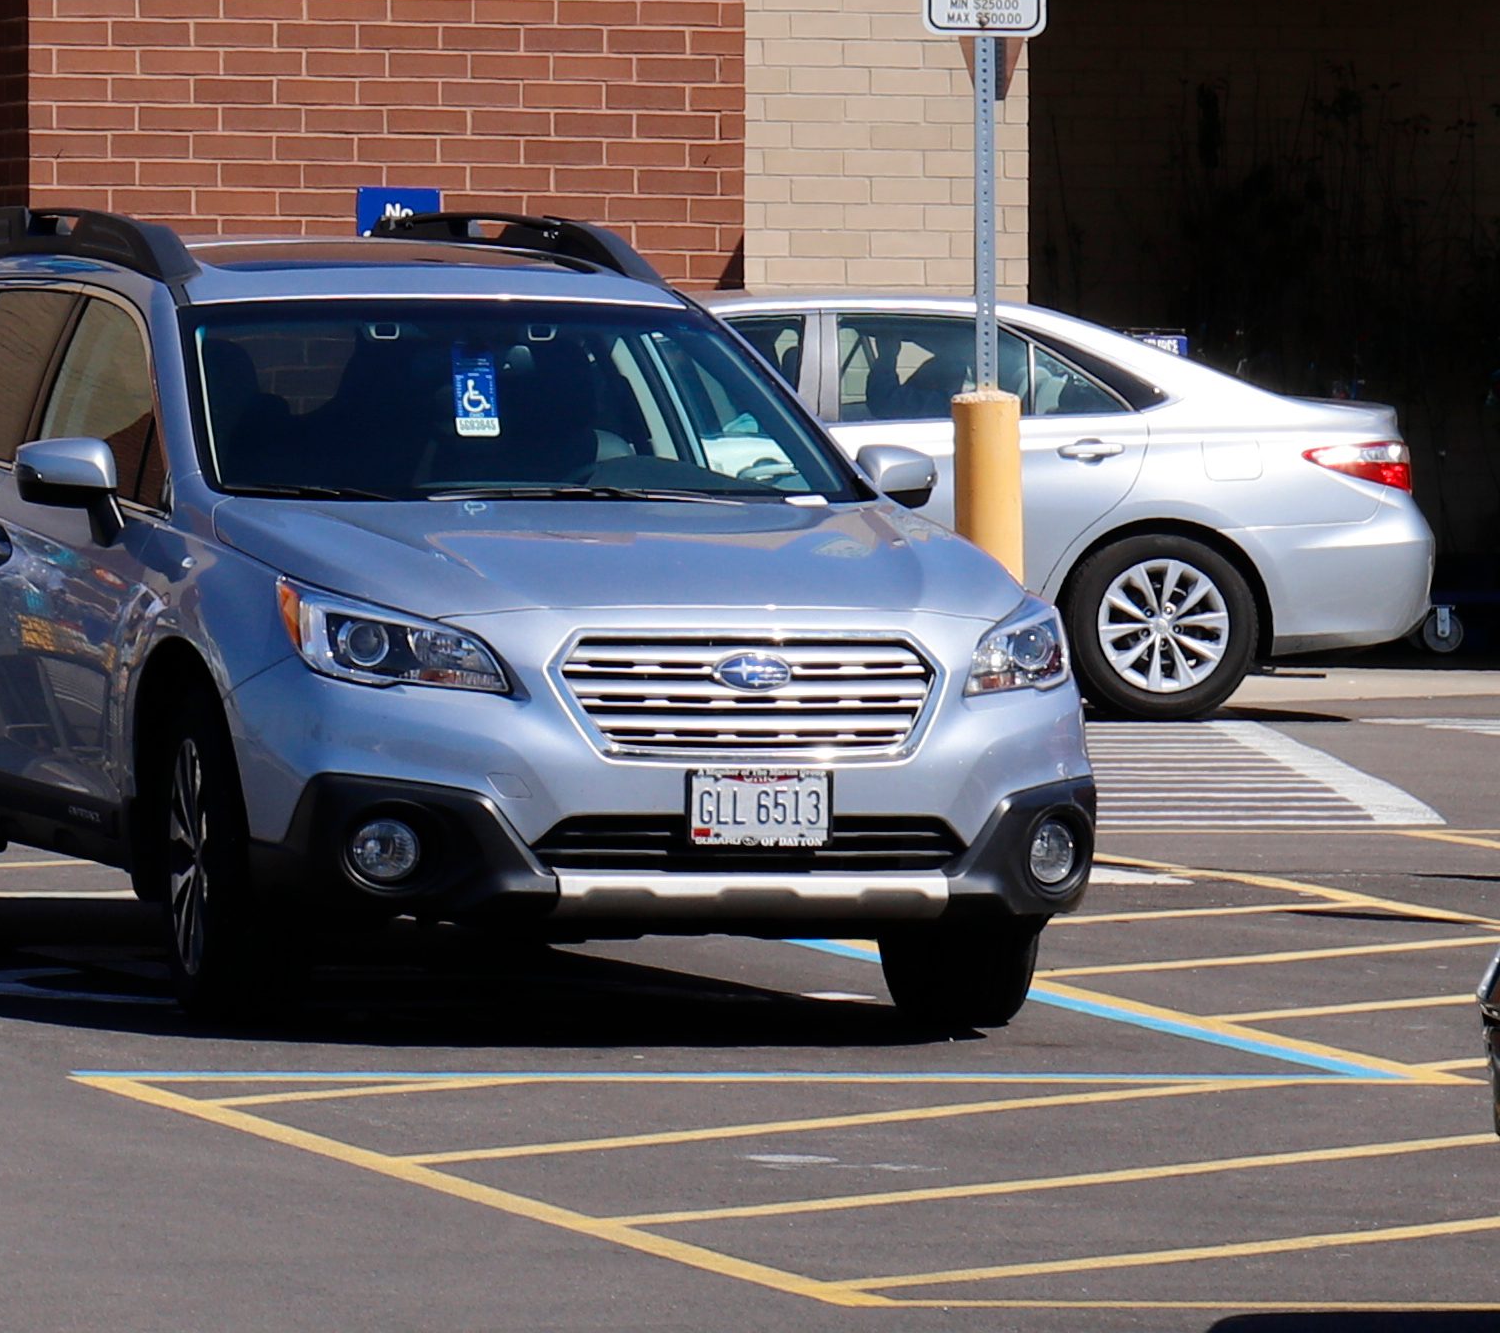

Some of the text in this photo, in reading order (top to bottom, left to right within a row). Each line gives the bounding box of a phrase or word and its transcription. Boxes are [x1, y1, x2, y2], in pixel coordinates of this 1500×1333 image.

[947, 12, 1022, 25] MAX $500.00
[700, 788, 821, 825] GLL 6513
[760, 837, 776, 846] OF
[778, 837, 823, 847] DAYTON
